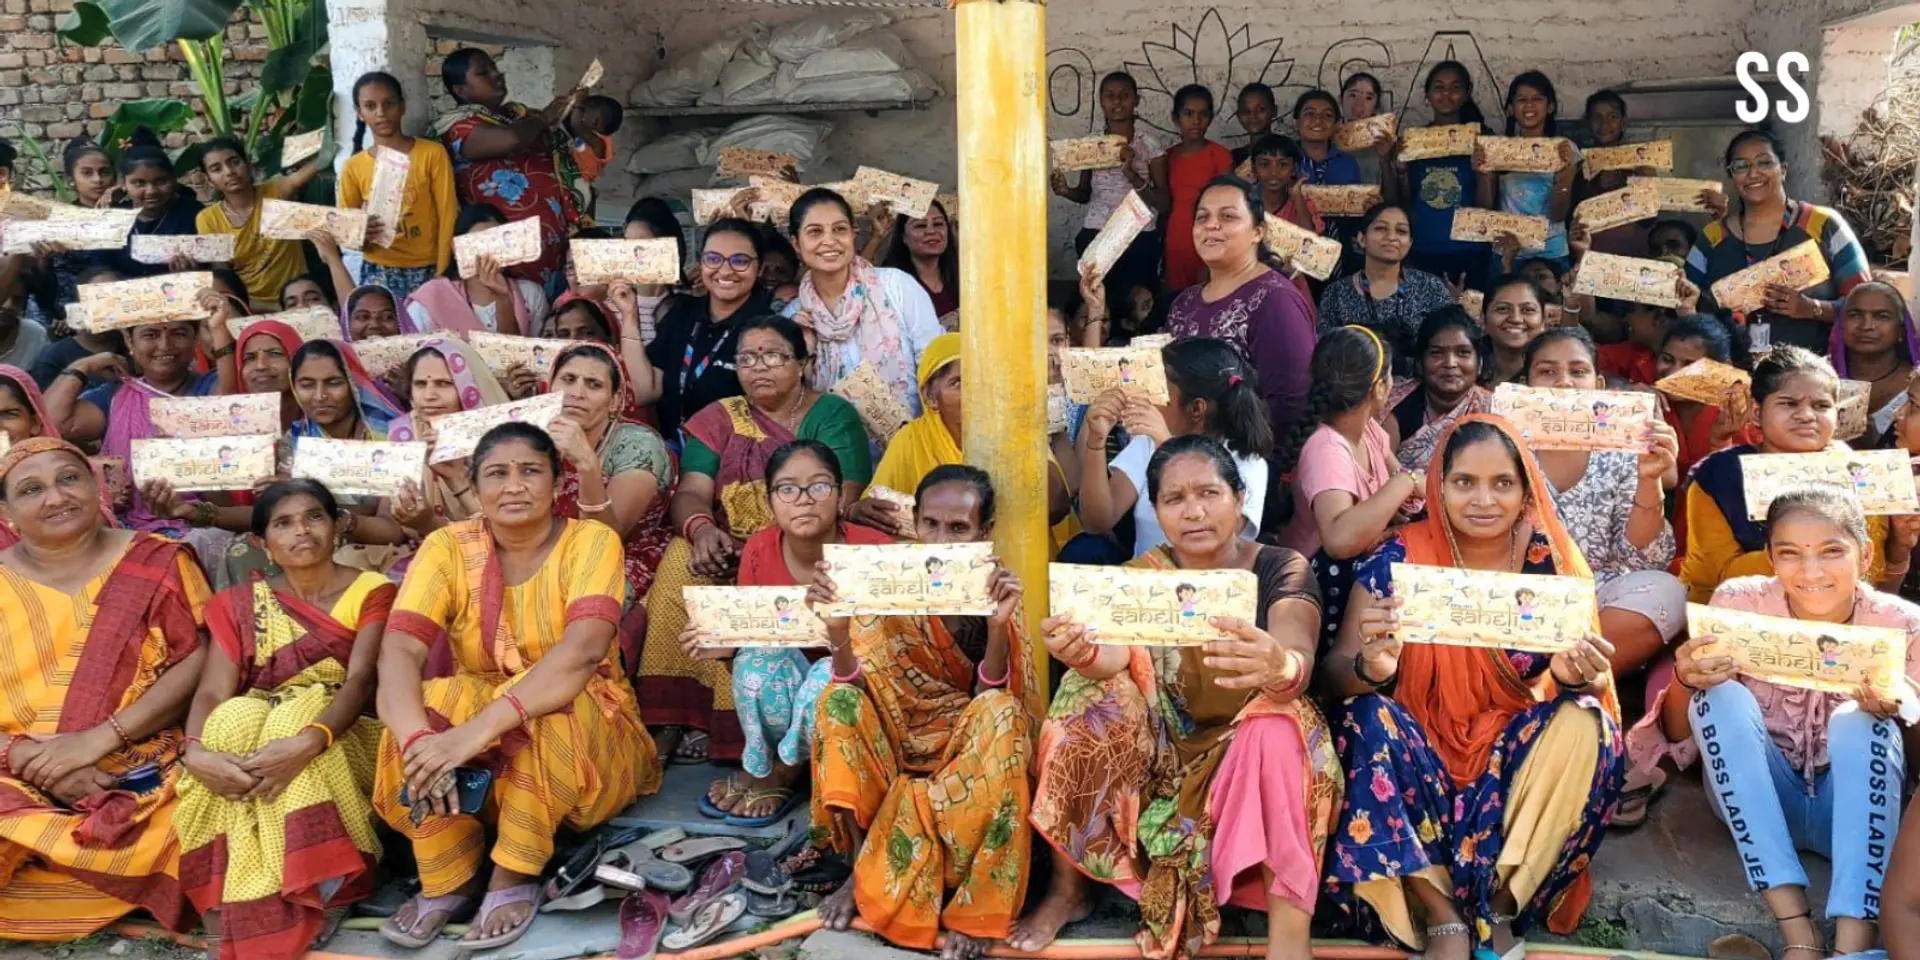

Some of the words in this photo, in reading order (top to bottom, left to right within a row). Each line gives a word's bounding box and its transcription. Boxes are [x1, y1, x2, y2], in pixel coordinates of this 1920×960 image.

[1541, 413, 1596, 435] saheli
[869, 572, 930, 598] saheli
[1111, 598, 1181, 627] saheli
[1450, 600, 1519, 629] saheli
[1749, 644, 1821, 675] saheli
[1701, 724, 1730, 785] BOSS
[1720, 790, 1754, 846] LADY
[1868, 740, 1888, 808] BOSS
[1866, 812, 1886, 876] LADY
